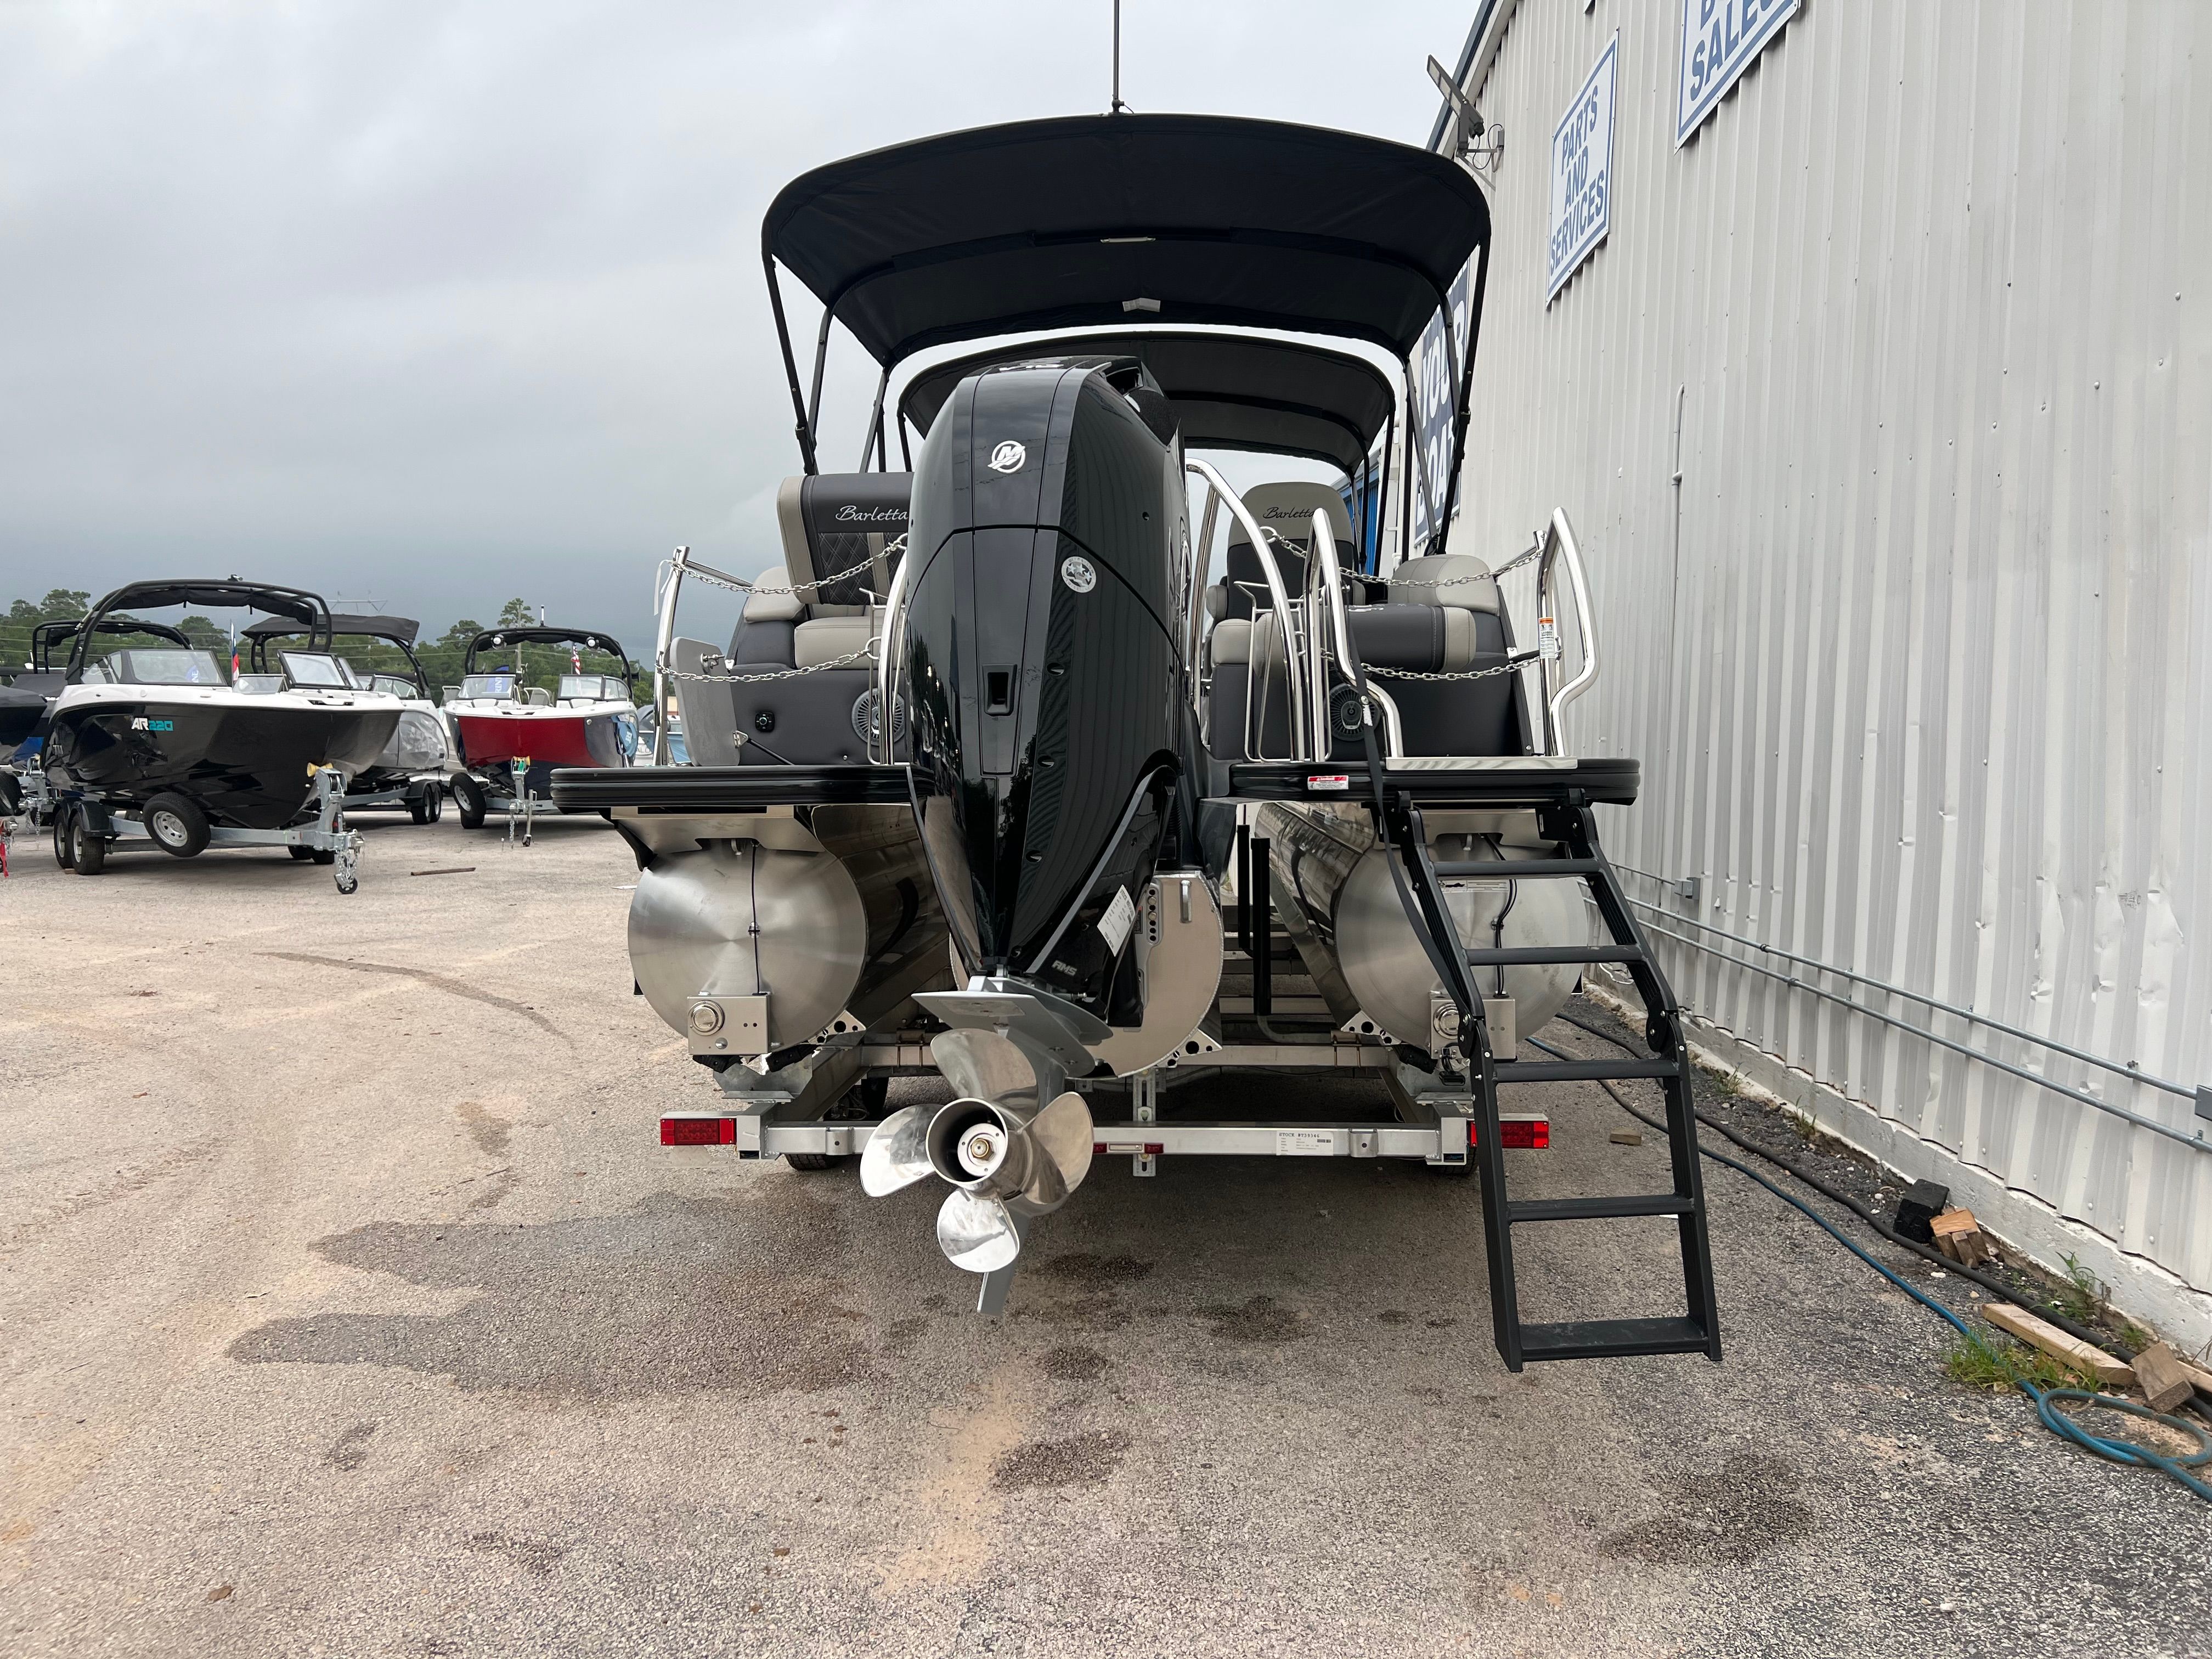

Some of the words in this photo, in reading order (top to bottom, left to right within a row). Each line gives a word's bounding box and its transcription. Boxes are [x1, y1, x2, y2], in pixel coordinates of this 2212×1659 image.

[1690, 0, 1774, 101] SALE
[1561, 85, 1598, 177] PARTS
[1550, 170, 1605, 276] SERVICES
[1564, 145, 1588, 215] AND
[835, 505, 909, 521] Barletta
